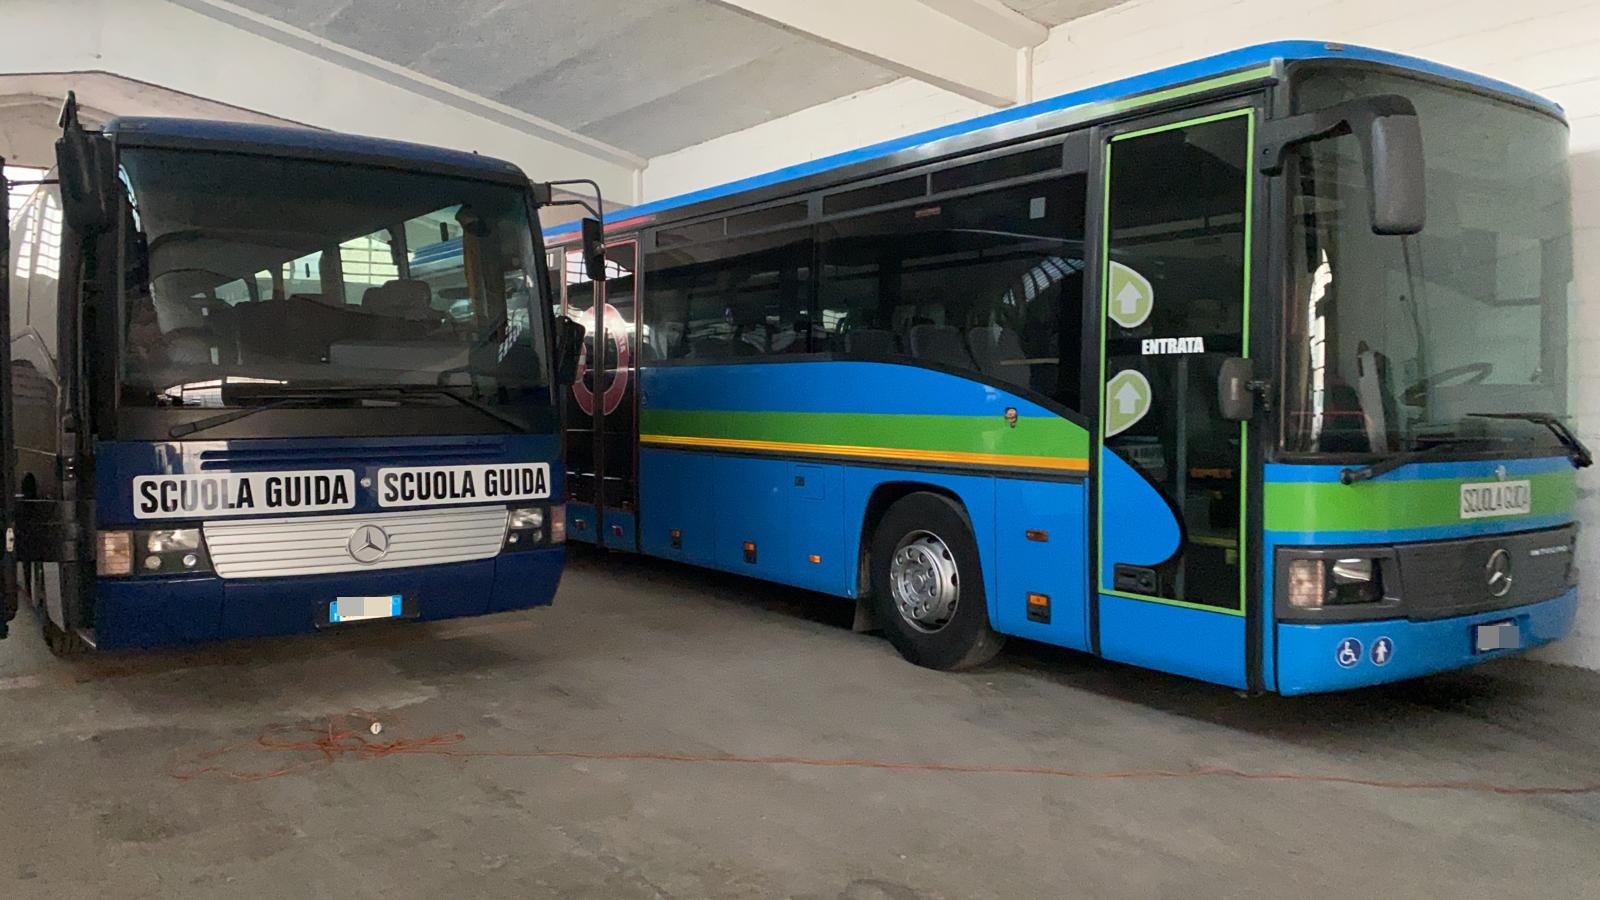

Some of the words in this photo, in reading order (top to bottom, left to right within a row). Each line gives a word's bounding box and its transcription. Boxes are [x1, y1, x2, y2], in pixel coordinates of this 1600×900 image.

[1141, 337, 1204, 355] ENTRATA
[140, 478, 254, 513] SCUOLA
[265, 475, 349, 508] GUIDA
[384, 470, 476, 502] SCUOLA
[485, 467, 547, 497] GUIDA
